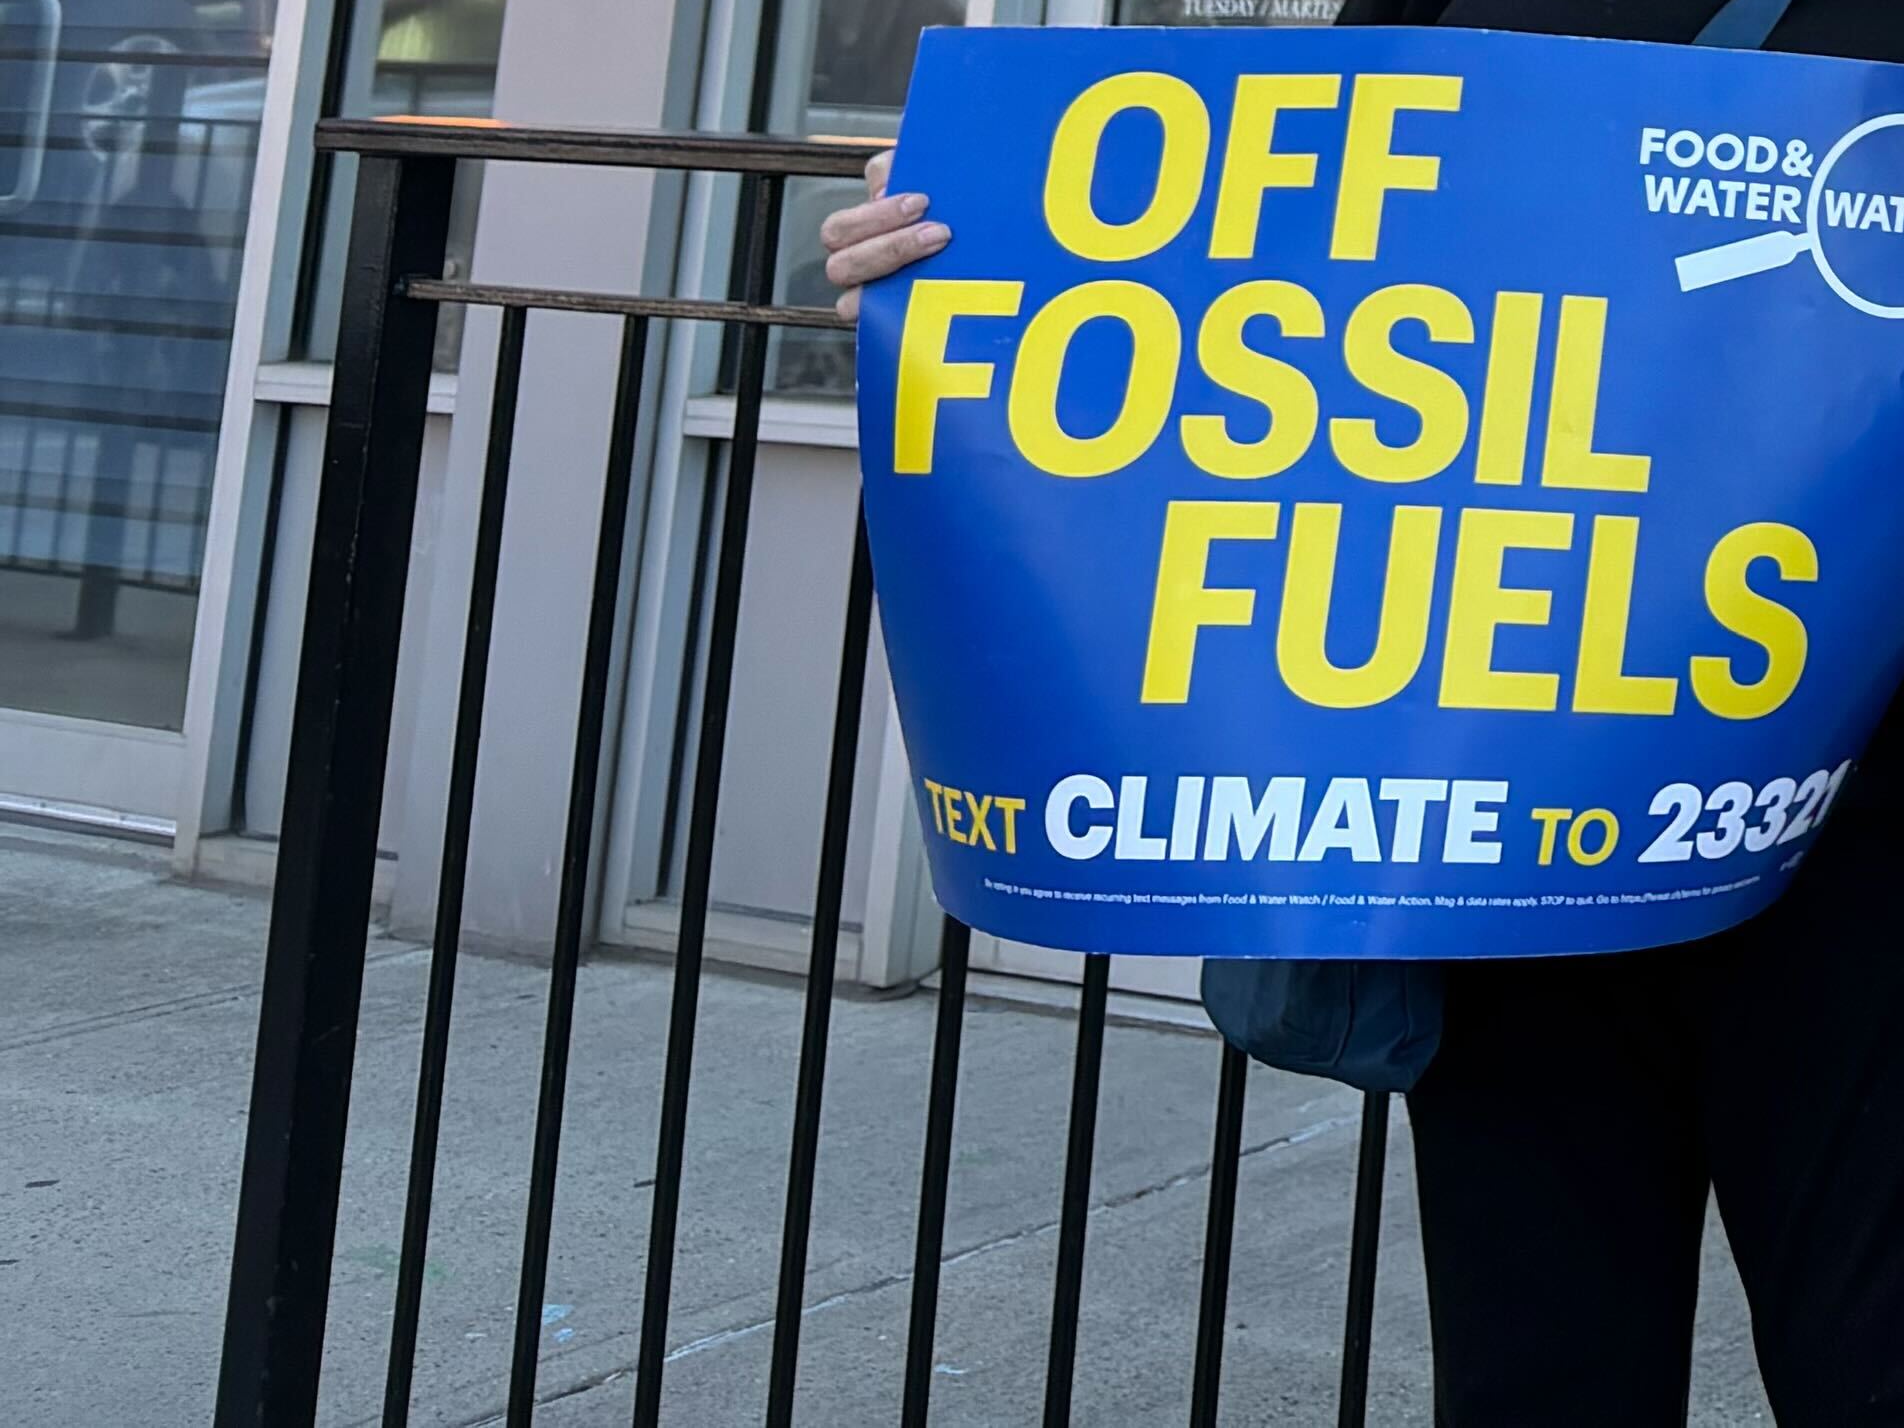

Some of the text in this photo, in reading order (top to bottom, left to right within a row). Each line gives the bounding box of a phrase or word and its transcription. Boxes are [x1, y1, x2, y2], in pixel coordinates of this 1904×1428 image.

[1047, 76, 1461, 261] OFF
[1644, 174, 1801, 224] WATER
[894, 281, 1649, 491] FOSSIL
[1142, 502, 1818, 720] FUELS
[924, 758, 1851, 866] TEXT CLIMATE TO 23321
